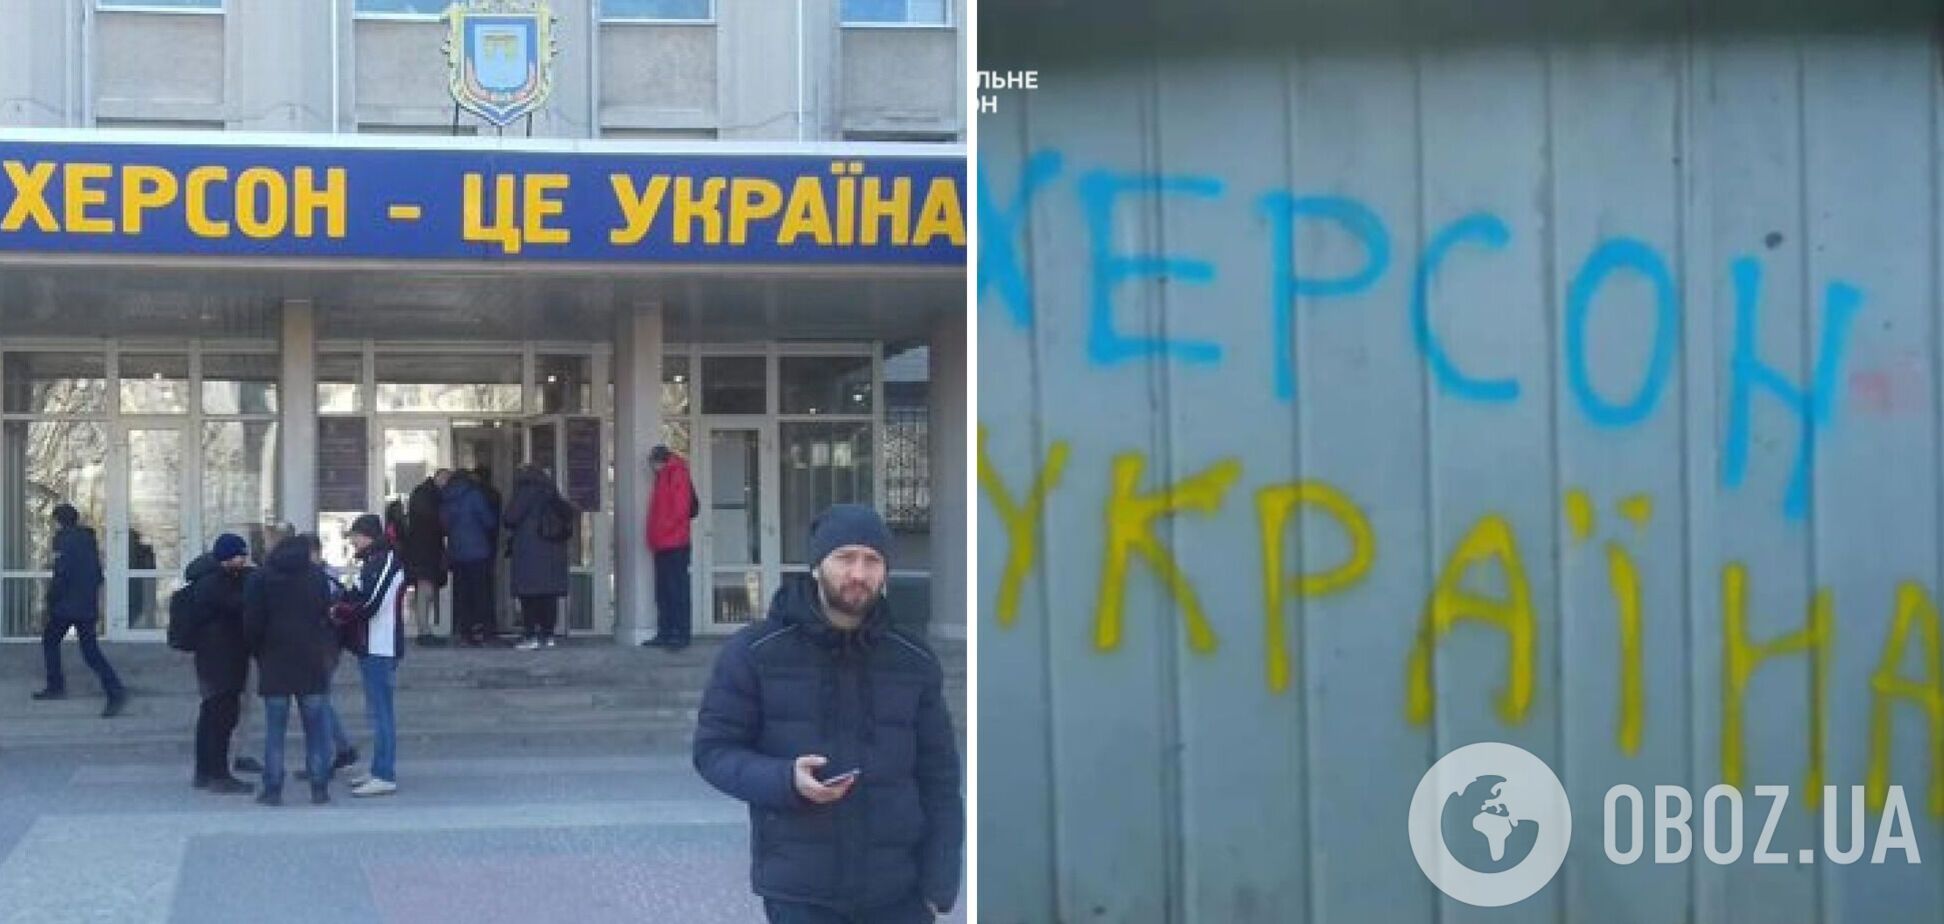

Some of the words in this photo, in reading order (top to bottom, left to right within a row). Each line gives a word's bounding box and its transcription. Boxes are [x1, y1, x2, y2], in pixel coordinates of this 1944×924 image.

[1, 160, 349, 241] ХЕРСОН
[388, 205, 422, 221] -
[462, 172, 571, 255] ЦЕ
[609, 161, 967, 248] УКРАЇНА
[977, 422, 1944, 822] УКРАЇНА
